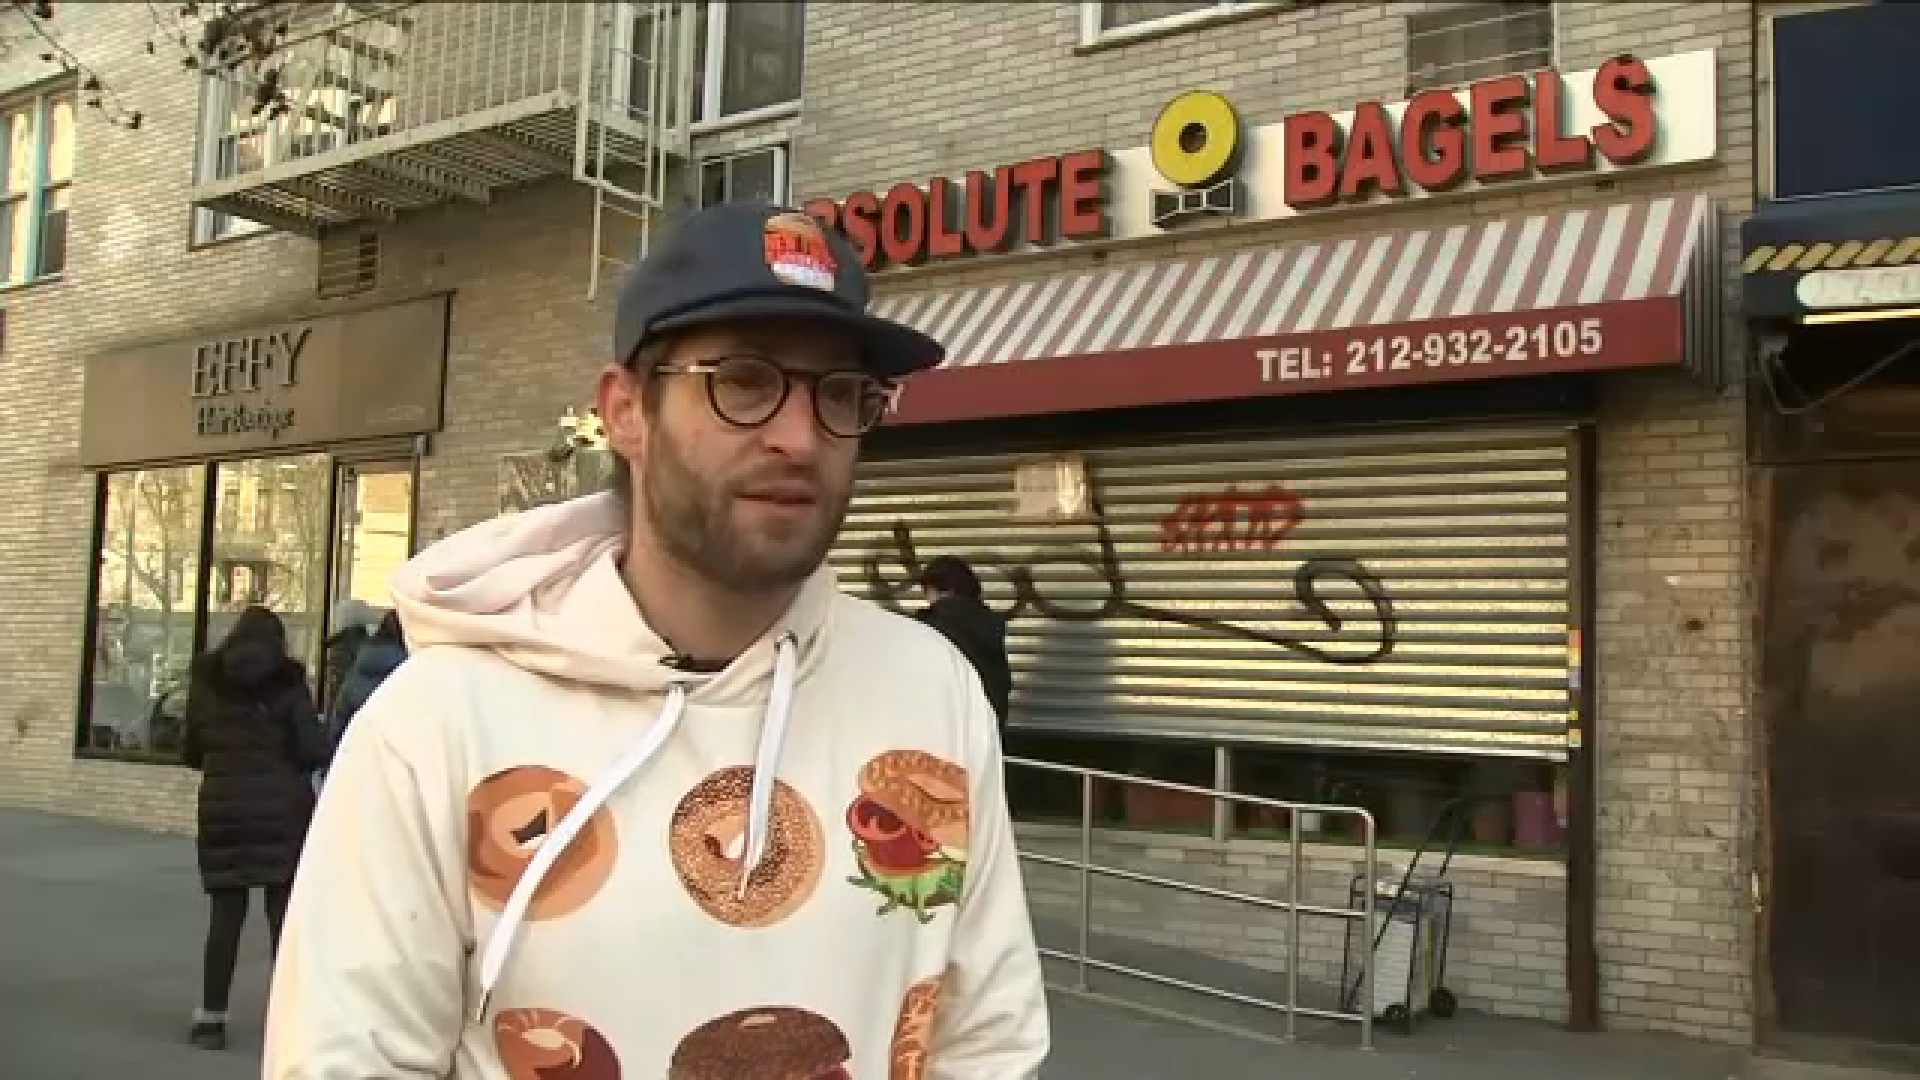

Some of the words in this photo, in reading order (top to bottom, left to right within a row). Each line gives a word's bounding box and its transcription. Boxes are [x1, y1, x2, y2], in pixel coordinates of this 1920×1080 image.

[1284, 54, 1657, 208] BAGELS
[191, 326, 313, 398] EFFY
[1255, 347, 1333, 382] TEL:
[1345, 318, 1603, 375] 212-932-2105
